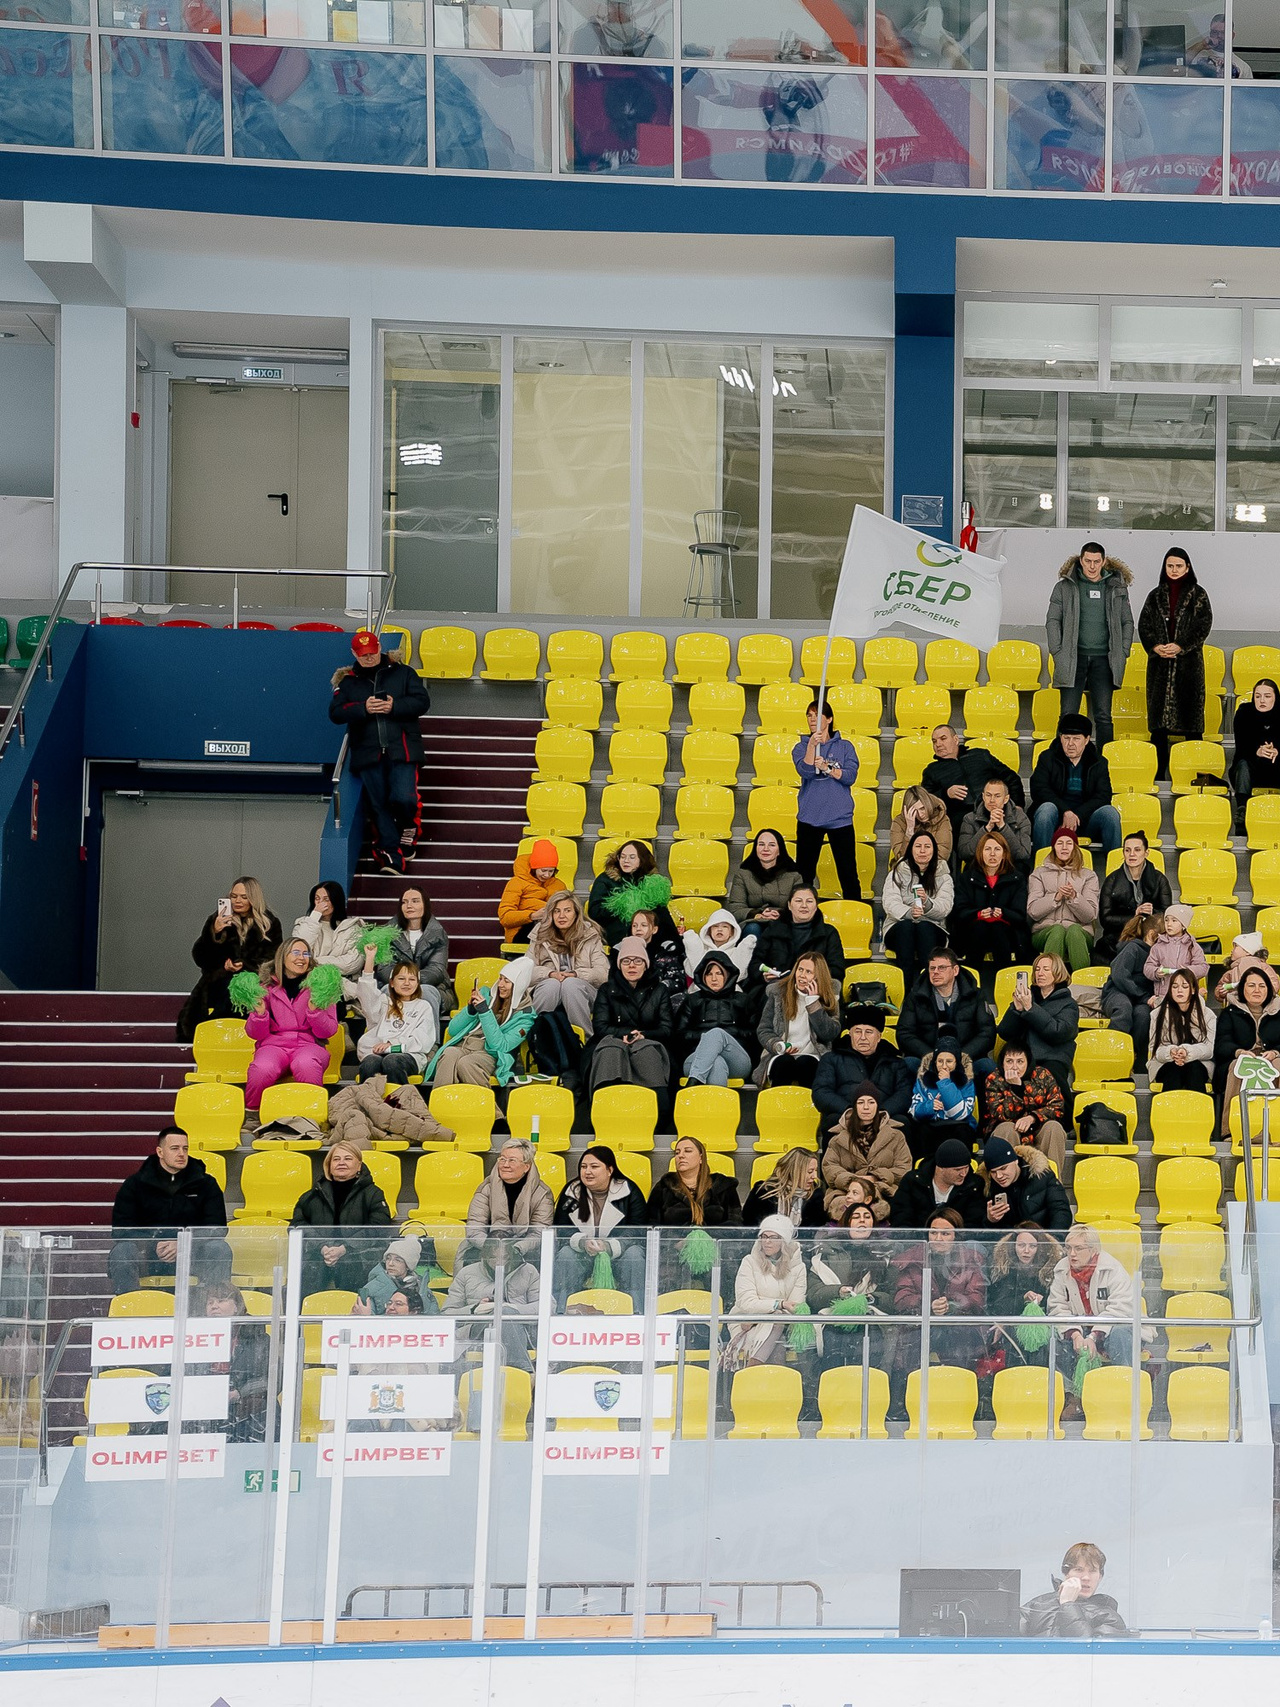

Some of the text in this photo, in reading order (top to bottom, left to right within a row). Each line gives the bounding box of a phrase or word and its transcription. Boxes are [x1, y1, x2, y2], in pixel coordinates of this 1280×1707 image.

[246, 368, 280, 378] ВЫХОД
[208, 743, 246, 754] ВЫХОД
[551, 1332, 671, 1346] OLIMPBT
[545, 1446, 665, 1460] OLIMPBT
